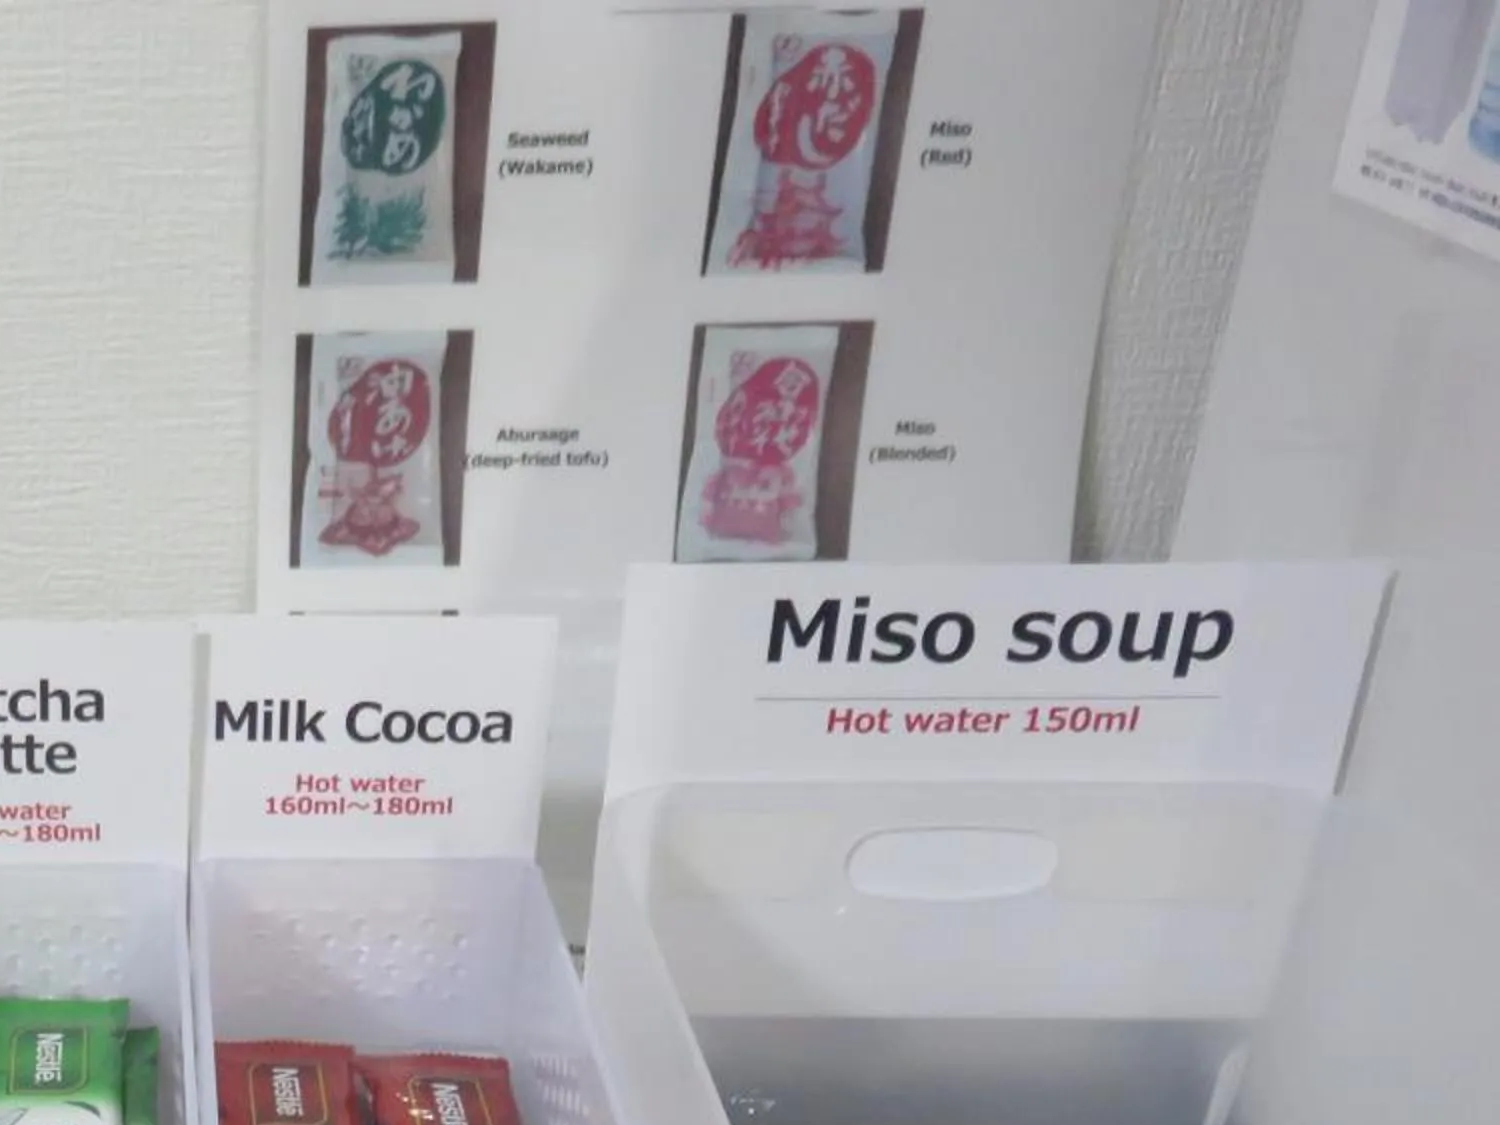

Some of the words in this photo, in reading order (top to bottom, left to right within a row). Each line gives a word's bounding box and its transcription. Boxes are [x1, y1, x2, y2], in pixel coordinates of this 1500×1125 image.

[507, 130, 590, 148] Seaweed
[930, 121, 972, 137] Miso
[499, 159, 594, 179] (Wakame)
[566, 450, 610, 469] tofu)
[766, 596, 976, 664] Miso
[1006, 607, 1236, 679] soup
[214, 698, 327, 743] Milk
[345, 700, 513, 744] Cocoa
[826, 708, 893, 734] Hot
[903, 708, 1011, 734] water
[1022, 705, 1141, 734] 150ml
[295, 773, 341, 794] Hot
[349, 773, 426, 794] water
